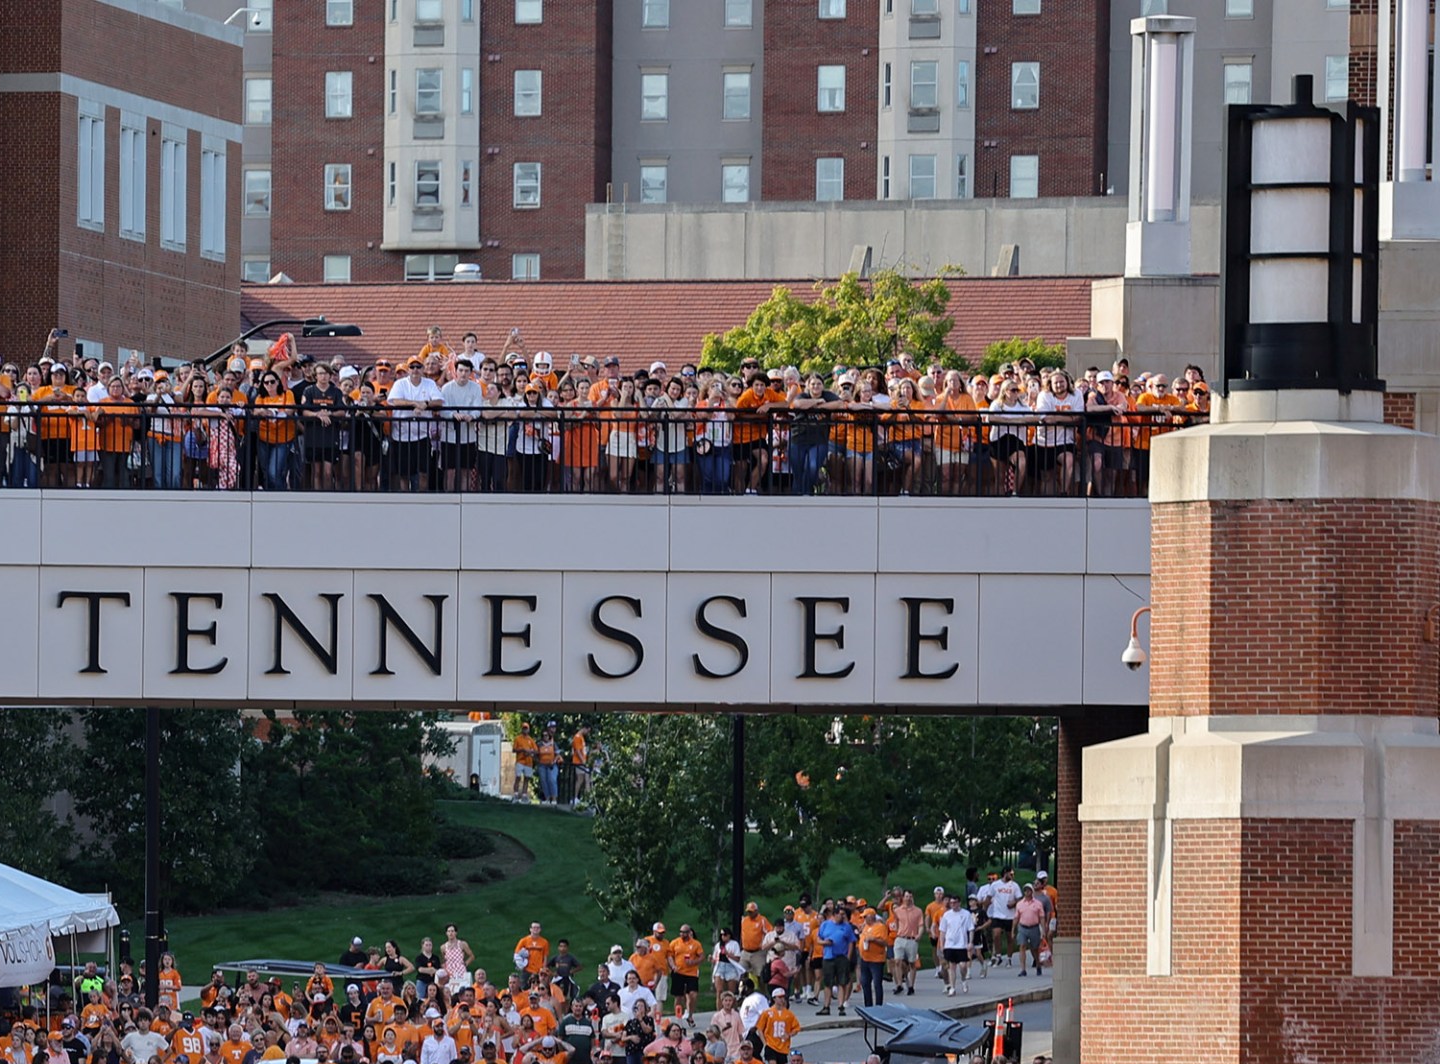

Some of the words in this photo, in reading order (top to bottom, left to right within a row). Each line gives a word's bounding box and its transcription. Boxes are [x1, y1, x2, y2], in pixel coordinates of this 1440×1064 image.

[56, 590, 960, 681] TENNESSEE
[351, 1012, 361, 1029] 5
[182, 1037, 201, 1054] 98
